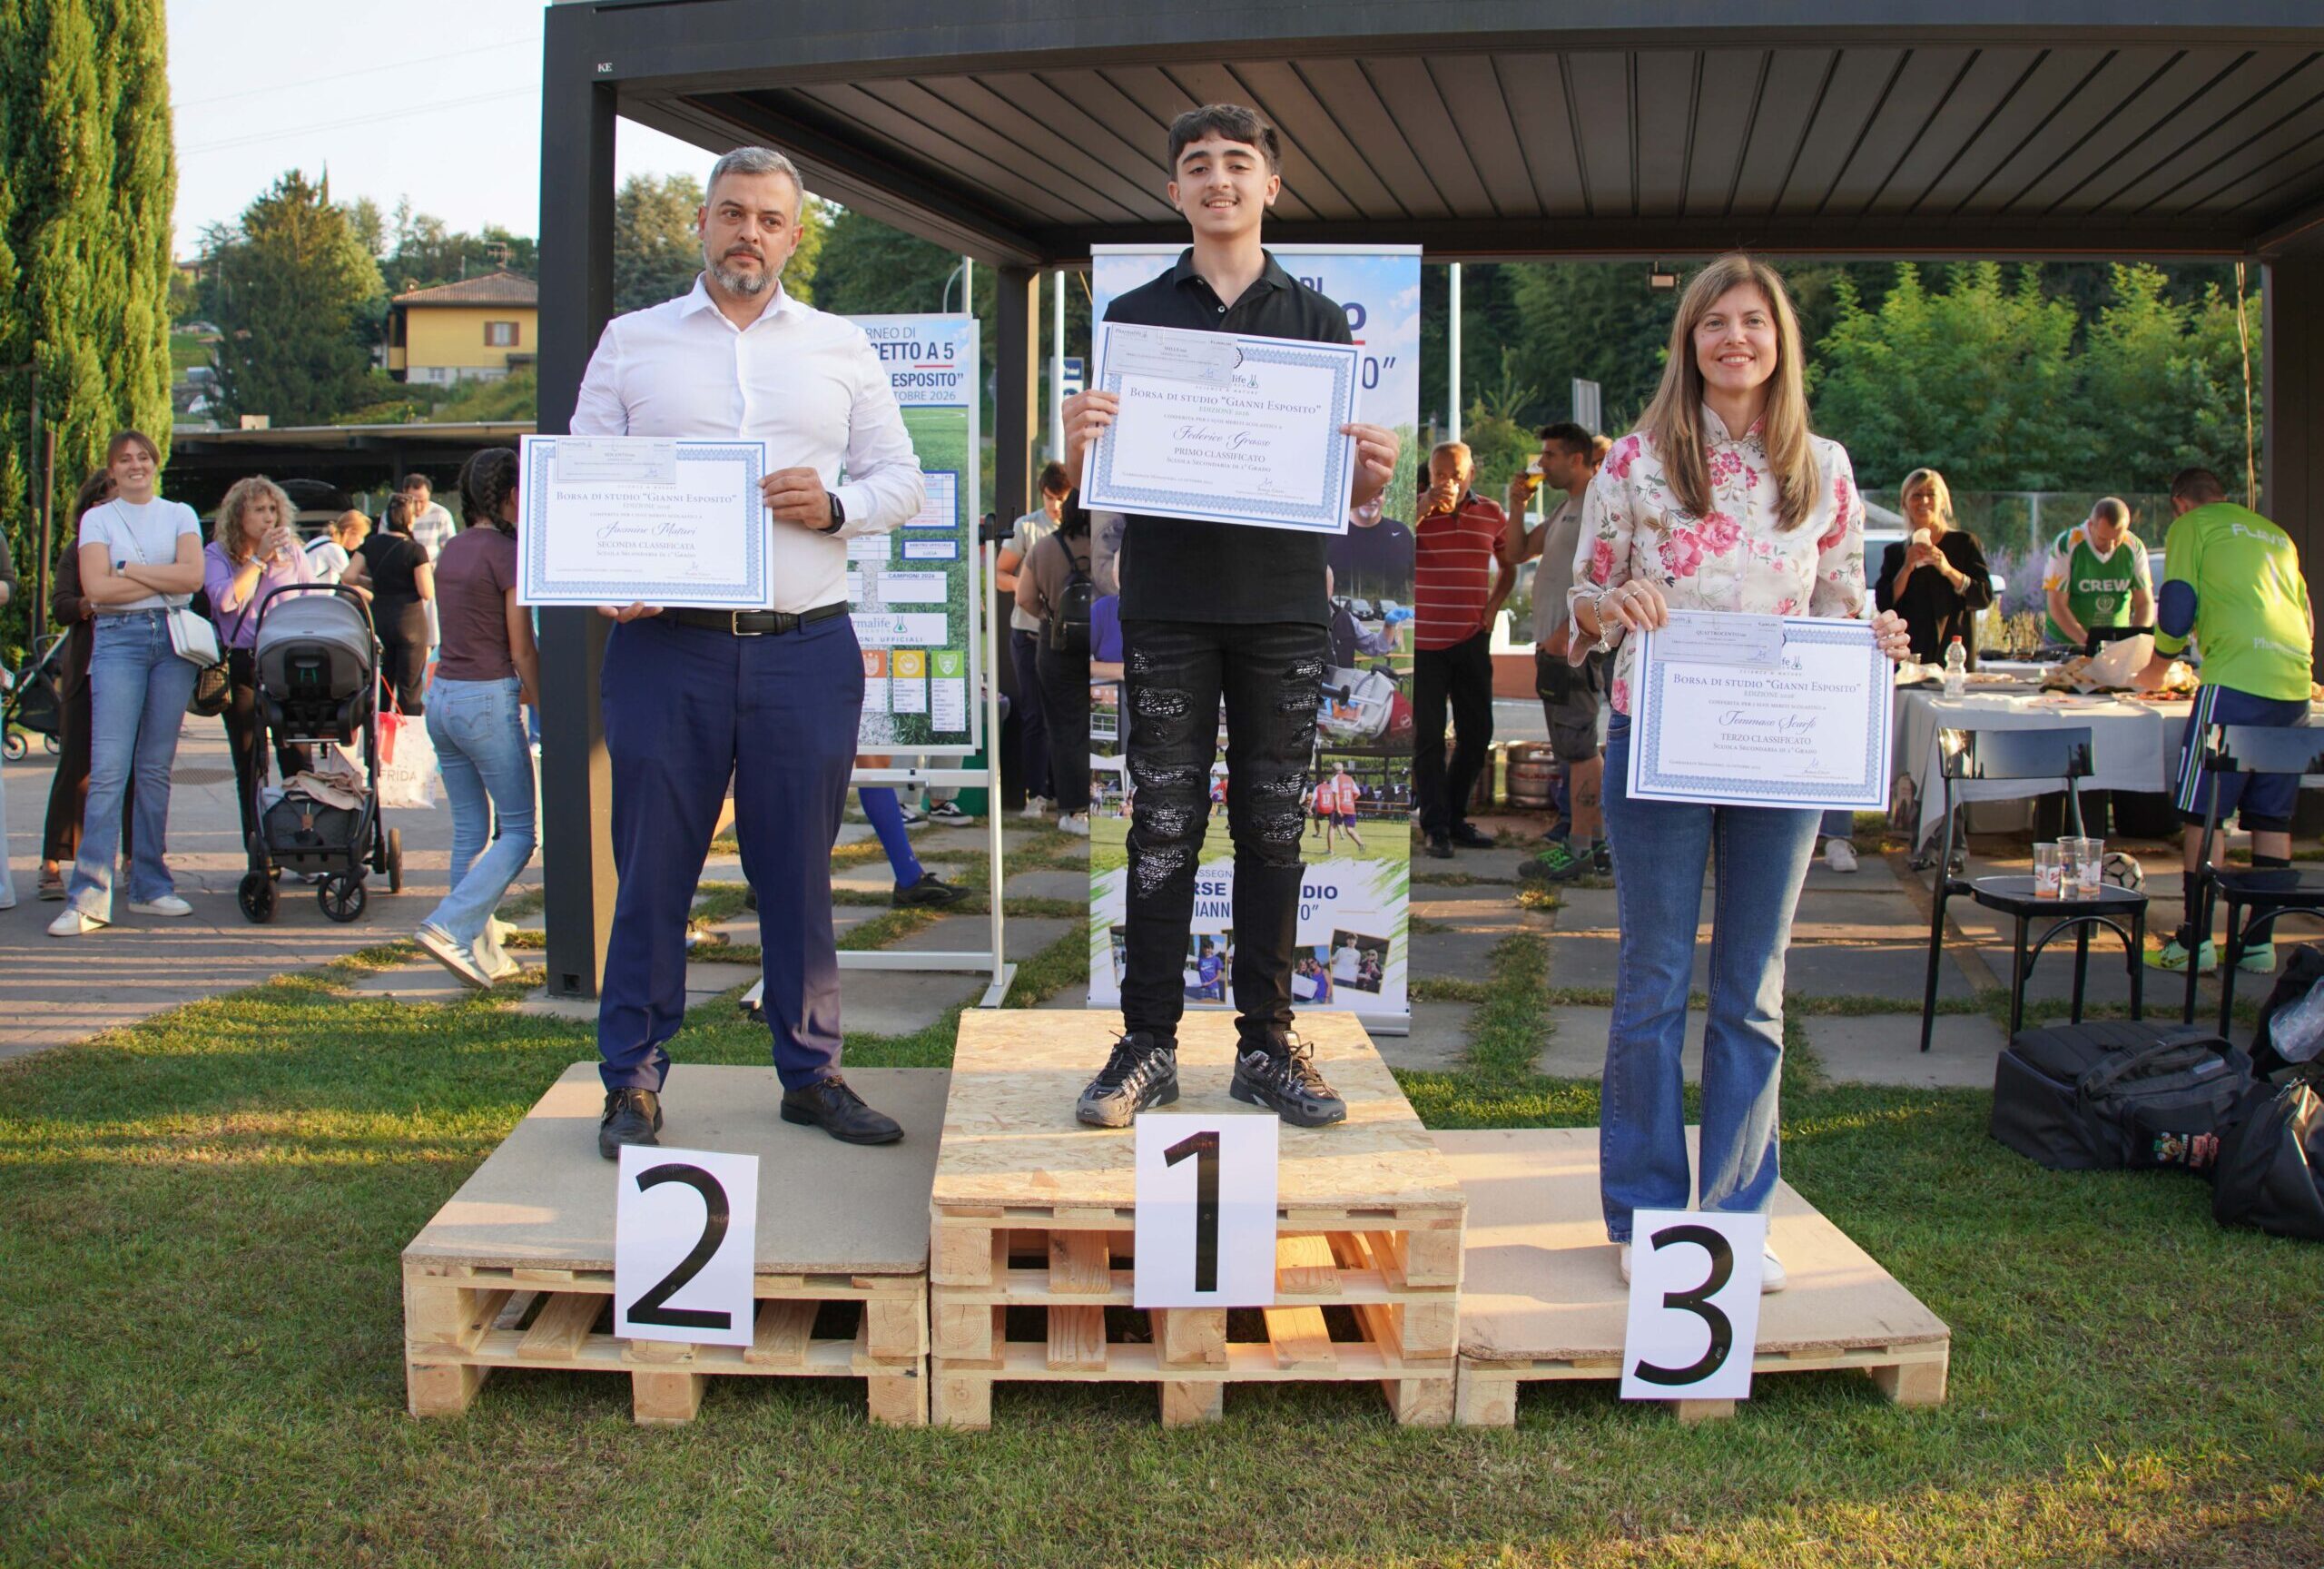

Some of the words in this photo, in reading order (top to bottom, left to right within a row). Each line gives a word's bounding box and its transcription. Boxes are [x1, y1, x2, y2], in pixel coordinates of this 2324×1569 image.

[865, 327, 900, 339] RNEO
[903, 327, 915, 339] DI
[927, 342, 939, 360] A
[944, 341, 954, 360] 5
[1231, 374, 1247, 385] life
[893, 391, 926, 400] TOBRE
[930, 390, 956, 400] 2026
[1174, 447, 1203, 457] PRIMO
[1204, 449, 1265, 463] CLASSIFICATO
[596, 541, 636, 549] SECONDA
[638, 541, 696, 550] CLASSIFICATA
[2078, 578, 2131, 593] CREW
[852, 617, 891, 628] rmalife
[1718, 710, 1774, 726] Tommaso
[1720, 733, 1749, 742] TERZO
[1751, 735, 1811, 745] CLASSIFICATO
[1196, 869, 1232, 878] SSEGN
[1195, 901, 1230, 918] IANN
[1162, 1130, 1220, 1293] 1
[626, 1162, 732, 1330] 2
[1633, 1224, 1735, 1386] 3
